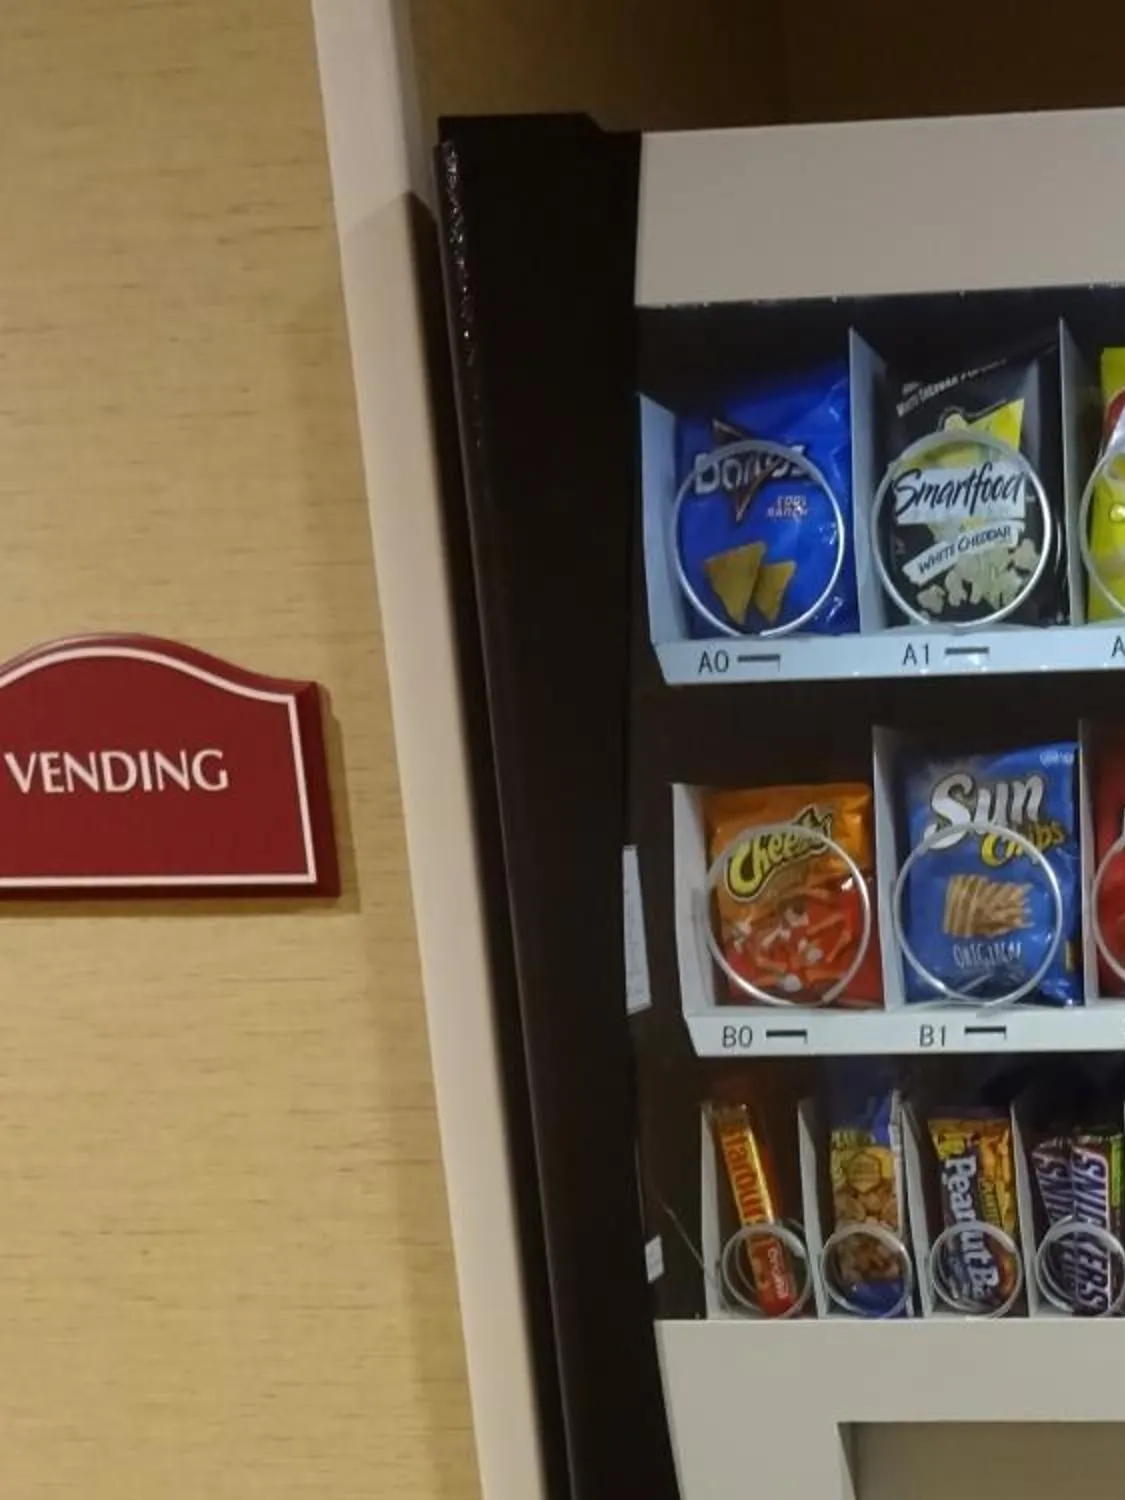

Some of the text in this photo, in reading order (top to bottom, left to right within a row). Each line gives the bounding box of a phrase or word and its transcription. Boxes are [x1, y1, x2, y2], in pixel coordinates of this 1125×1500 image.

[893, 461, 1025, 516] Smartfood
[698, 650, 730, 673] A0
[902, 642, 931, 666] A1
[4, 748, 229, 793] VENDING
[923, 773, 1044, 849] Sun
[727, 805, 832, 898] Chee
[722, 1026, 753, 1048] B0
[919, 1024, 946, 1047] B1
